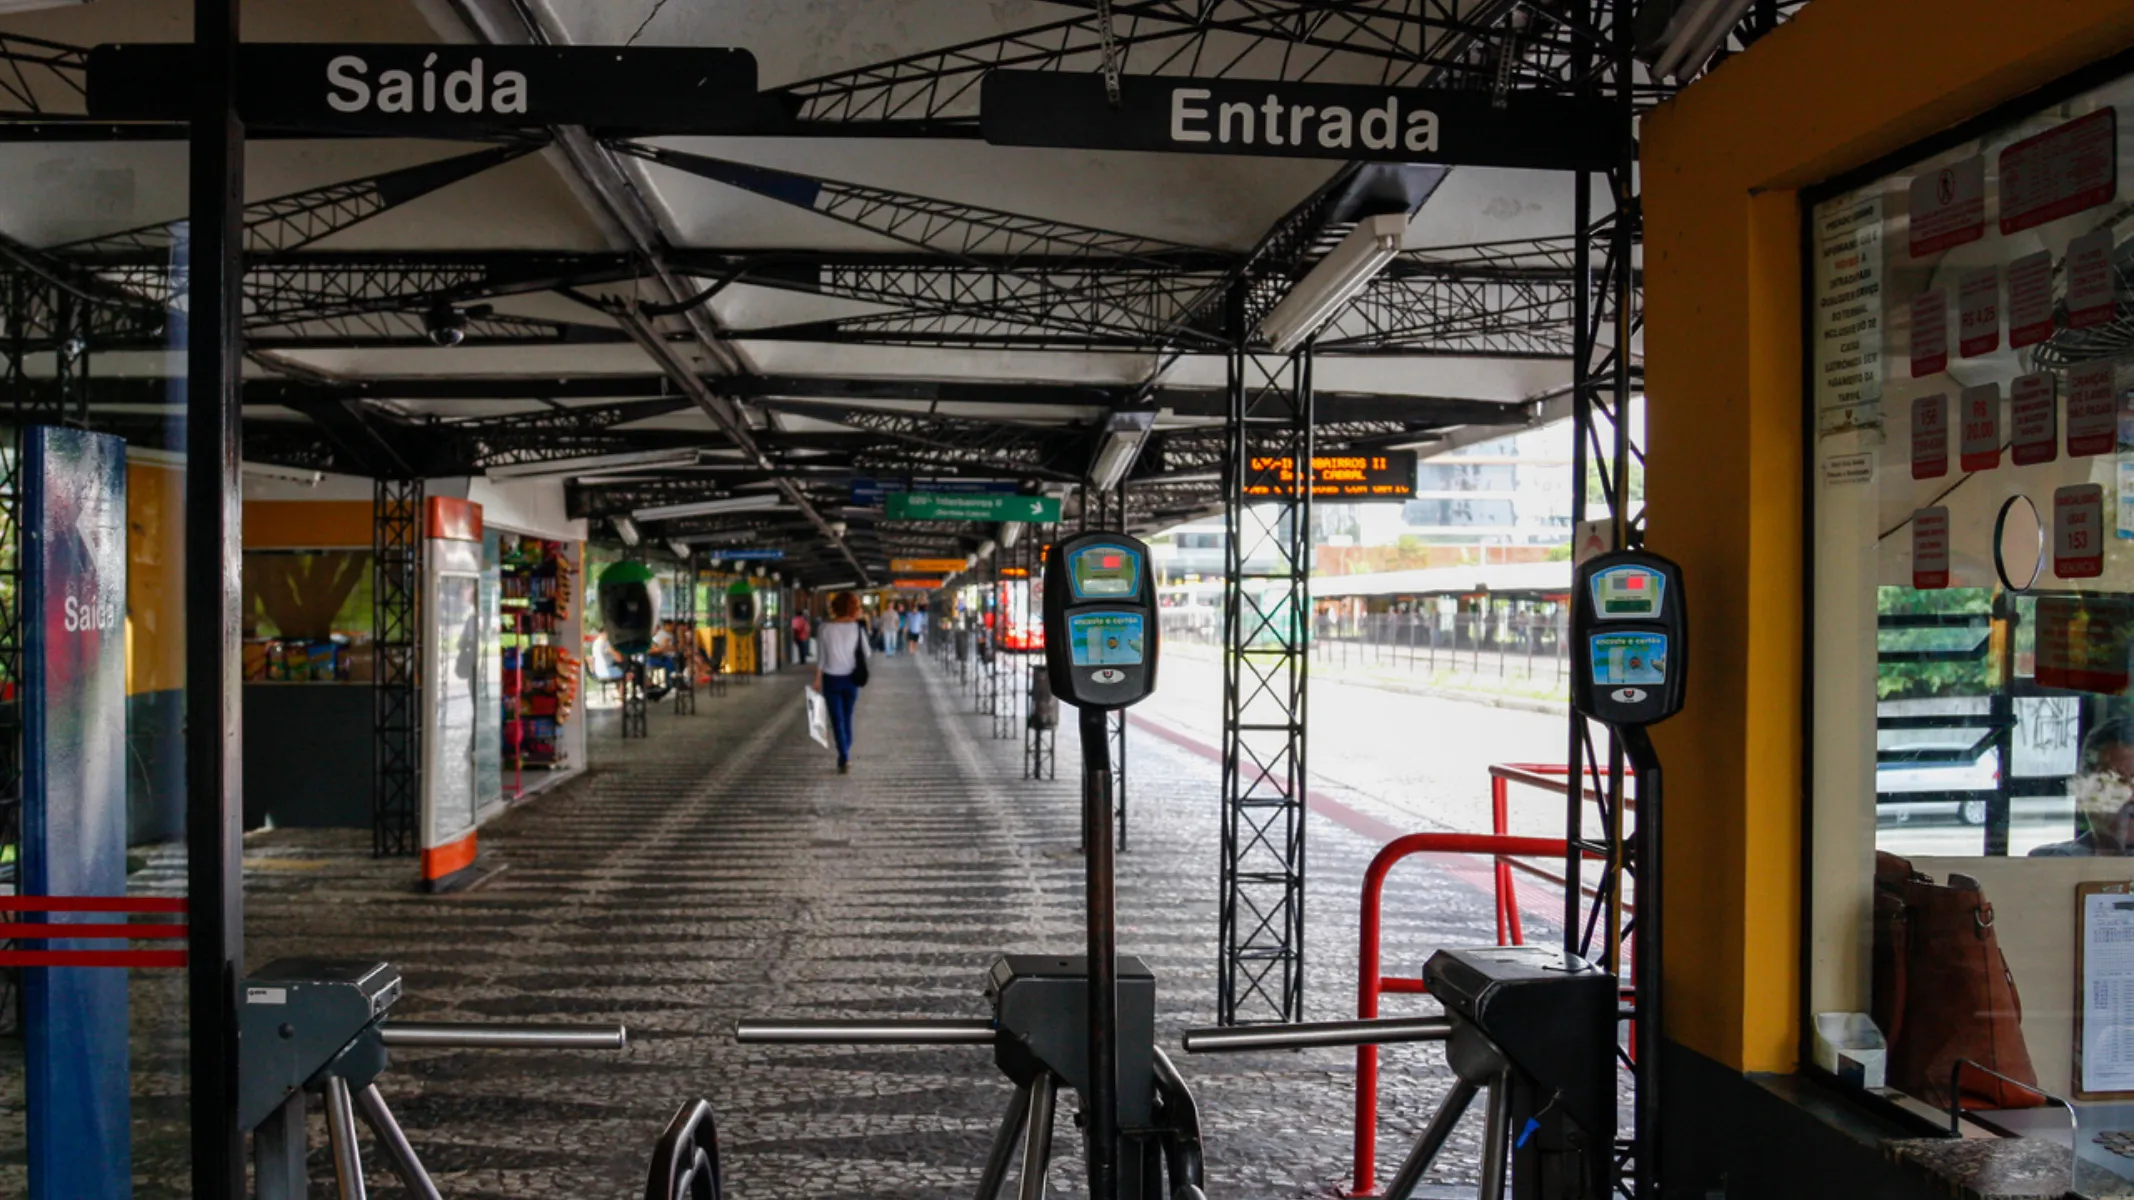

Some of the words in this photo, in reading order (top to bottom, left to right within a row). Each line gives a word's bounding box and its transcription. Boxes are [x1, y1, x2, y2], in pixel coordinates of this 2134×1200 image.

[326, 52, 529, 114] Saída
[1171, 88, 1440, 153] Entrada
[2067, 530, 2088, 549] 153
[65, 595, 114, 633] Saída
